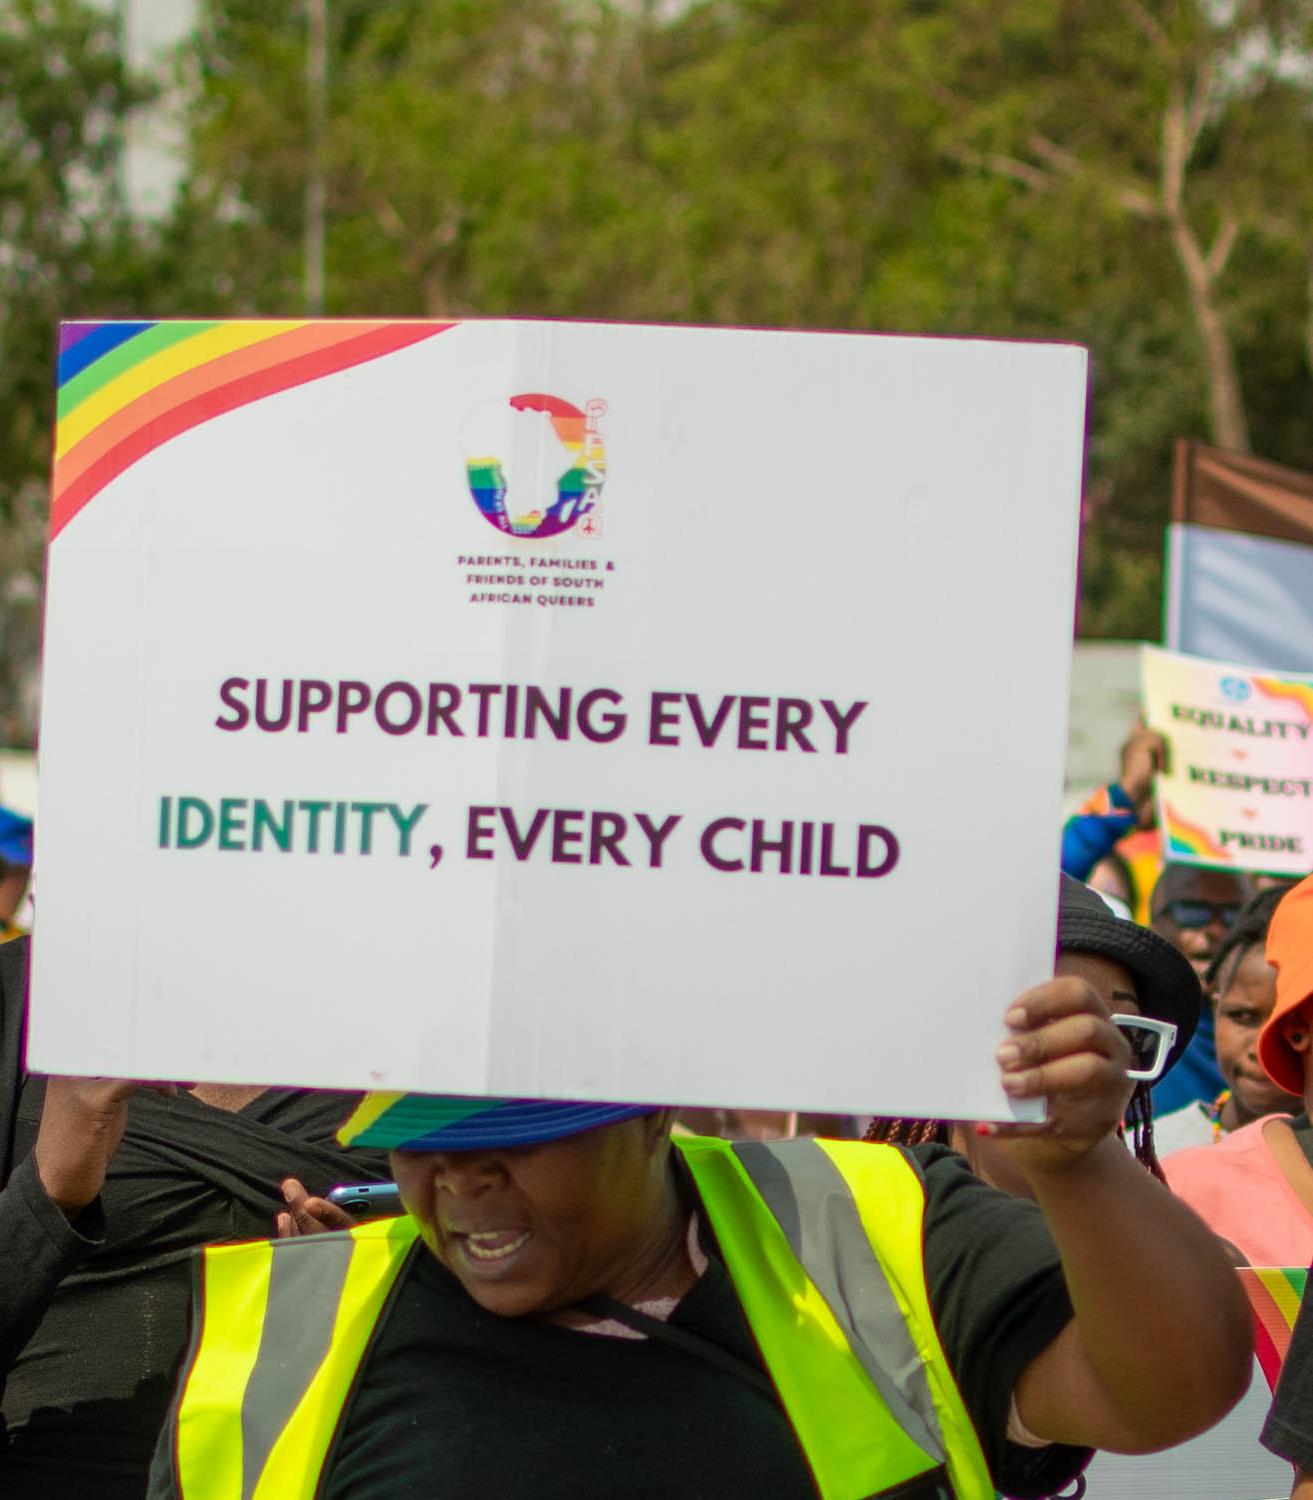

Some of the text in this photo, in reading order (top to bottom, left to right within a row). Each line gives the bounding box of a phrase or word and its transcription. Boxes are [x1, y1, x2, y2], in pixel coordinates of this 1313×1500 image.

[457, 555, 615, 572] PARENTS, FAMILIES &
[466, 574, 604, 589] FRIENDS OF SOUTH
[470, 592, 595, 608] AFRICAN QUEERS
[214, 676, 869, 755] SUPPORTING EVERY
[1170, 704, 1311, 738] EQUALITY
[1188, 765, 1312, 796] RESPECT
[157, 796, 900, 879] IDENTITY, EVERY CHILD
[1218, 829, 1303, 853] PRIDE
